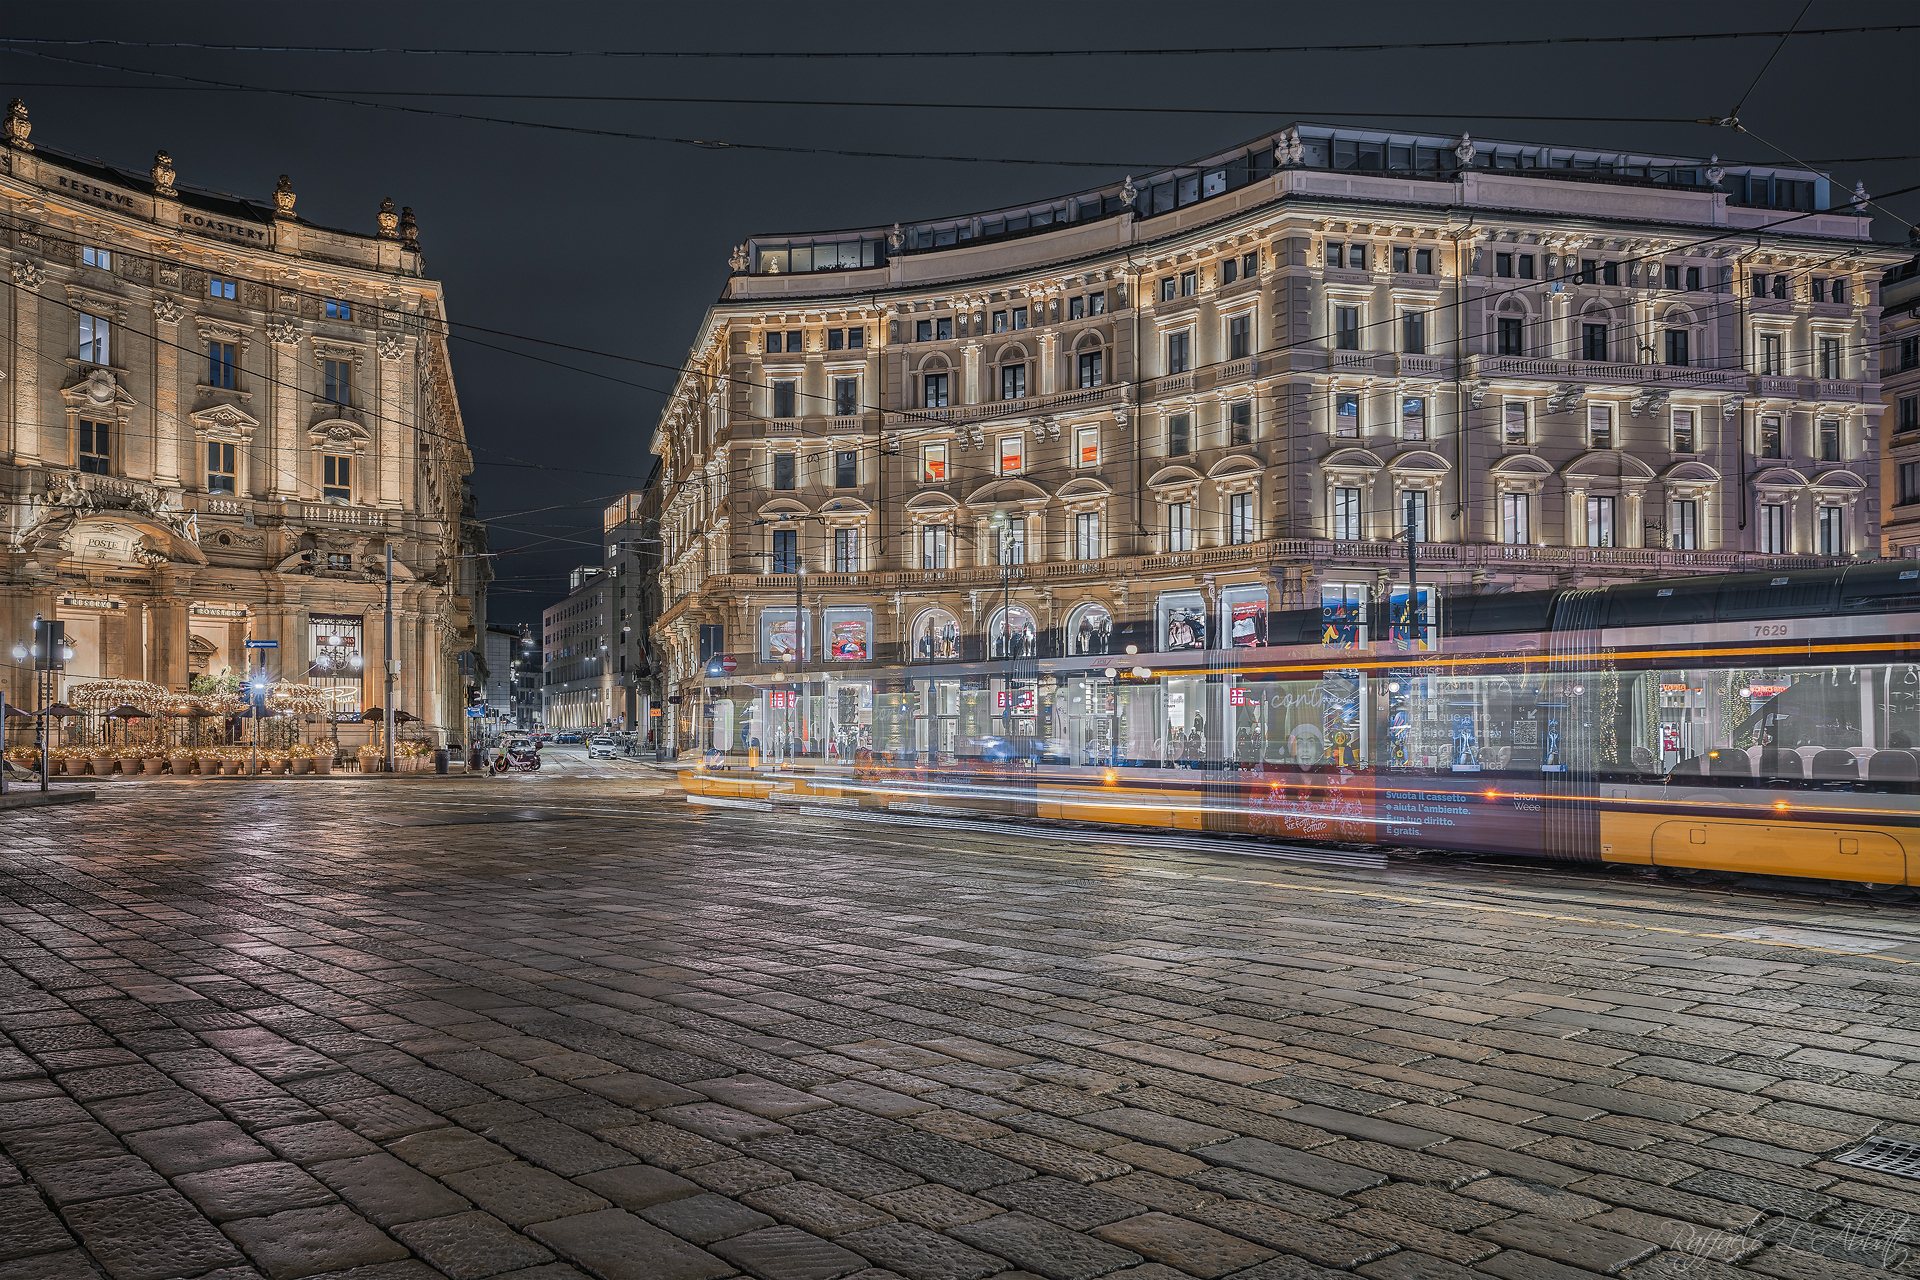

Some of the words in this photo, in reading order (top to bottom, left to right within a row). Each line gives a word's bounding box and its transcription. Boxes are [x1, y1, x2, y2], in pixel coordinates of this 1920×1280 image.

[59, 176, 134, 208] RESERVE
[183, 213, 265, 240] ROASTERY
[88, 538, 119, 549] POSTE
[1754, 625, 1788, 637] 7629
[1386, 790, 1417, 800] Svuota
[1418, 791, 1425, 801] il
[1426, 793, 1467, 803] cassetto
[1393, 803, 1417, 812] aiuta
[1418, 803, 1471, 815] l'ambiente.
[1513, 802, 1541, 812] Weee
[1423, 816, 1456, 827] diritto.
[1386, 824, 1392, 834] È
[1393, 826, 1422, 837] gratis.
